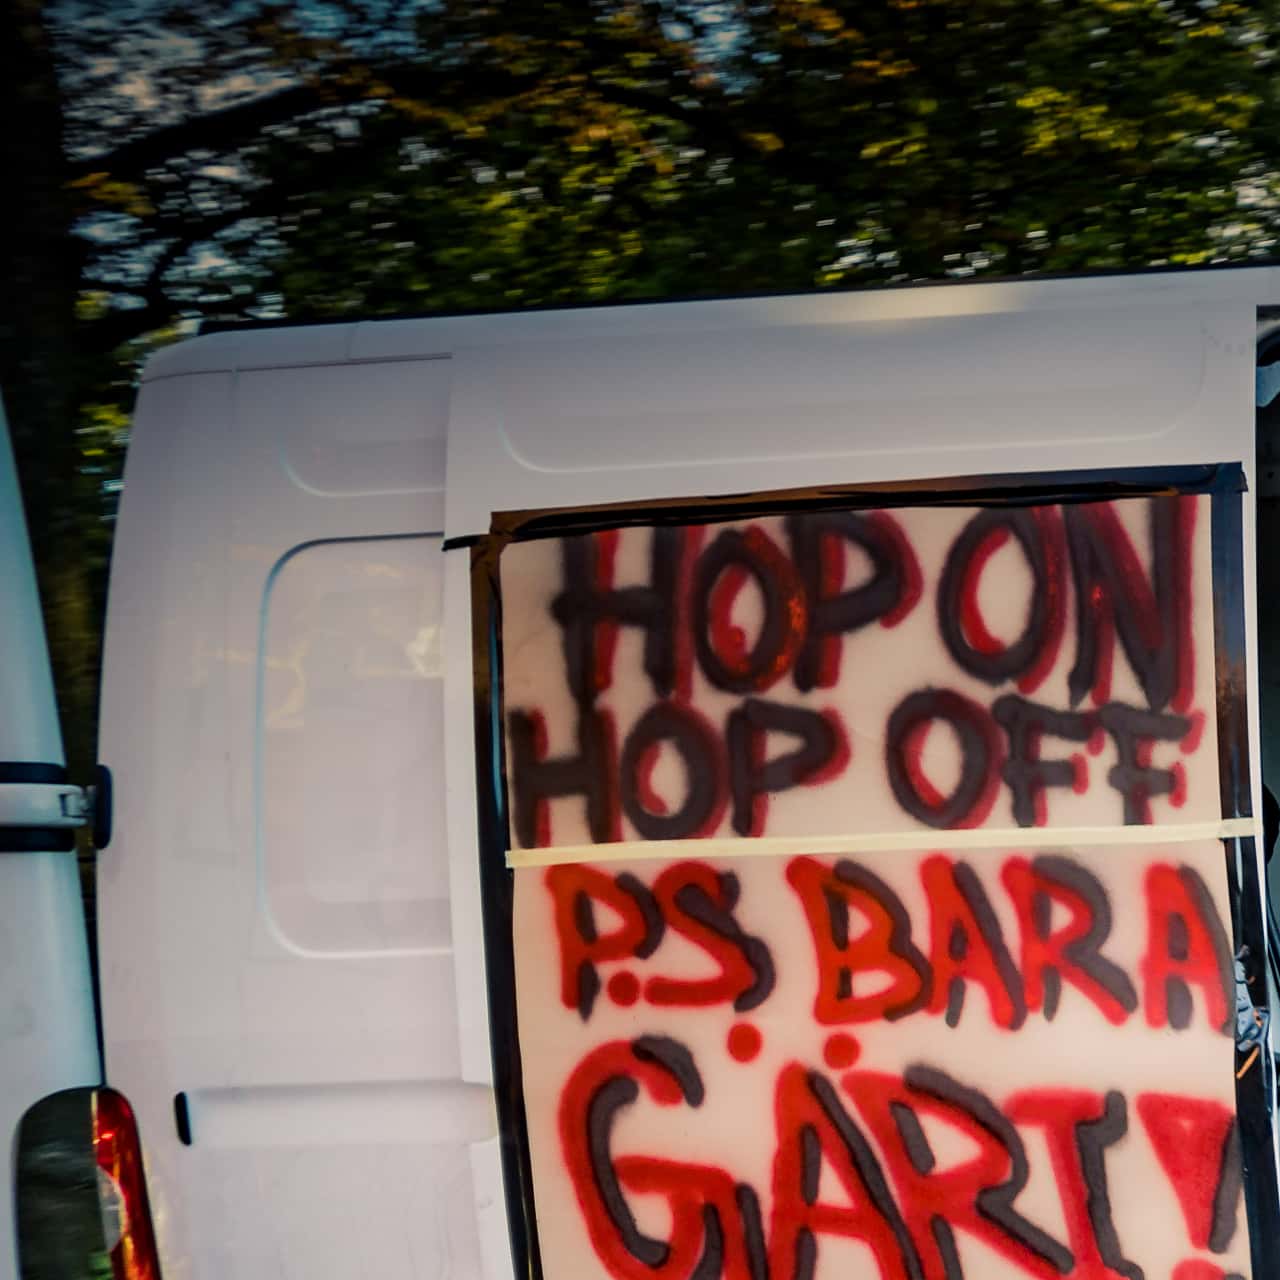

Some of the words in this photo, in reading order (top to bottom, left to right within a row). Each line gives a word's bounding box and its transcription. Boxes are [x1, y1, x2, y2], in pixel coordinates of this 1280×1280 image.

[553, 508, 925, 704] HOP
[937, 495, 1200, 712] ON
[509, 694, 852, 849] HOP
[886, 687, 1205, 830] OFF
[786, 852, 1235, 1034] BARA
